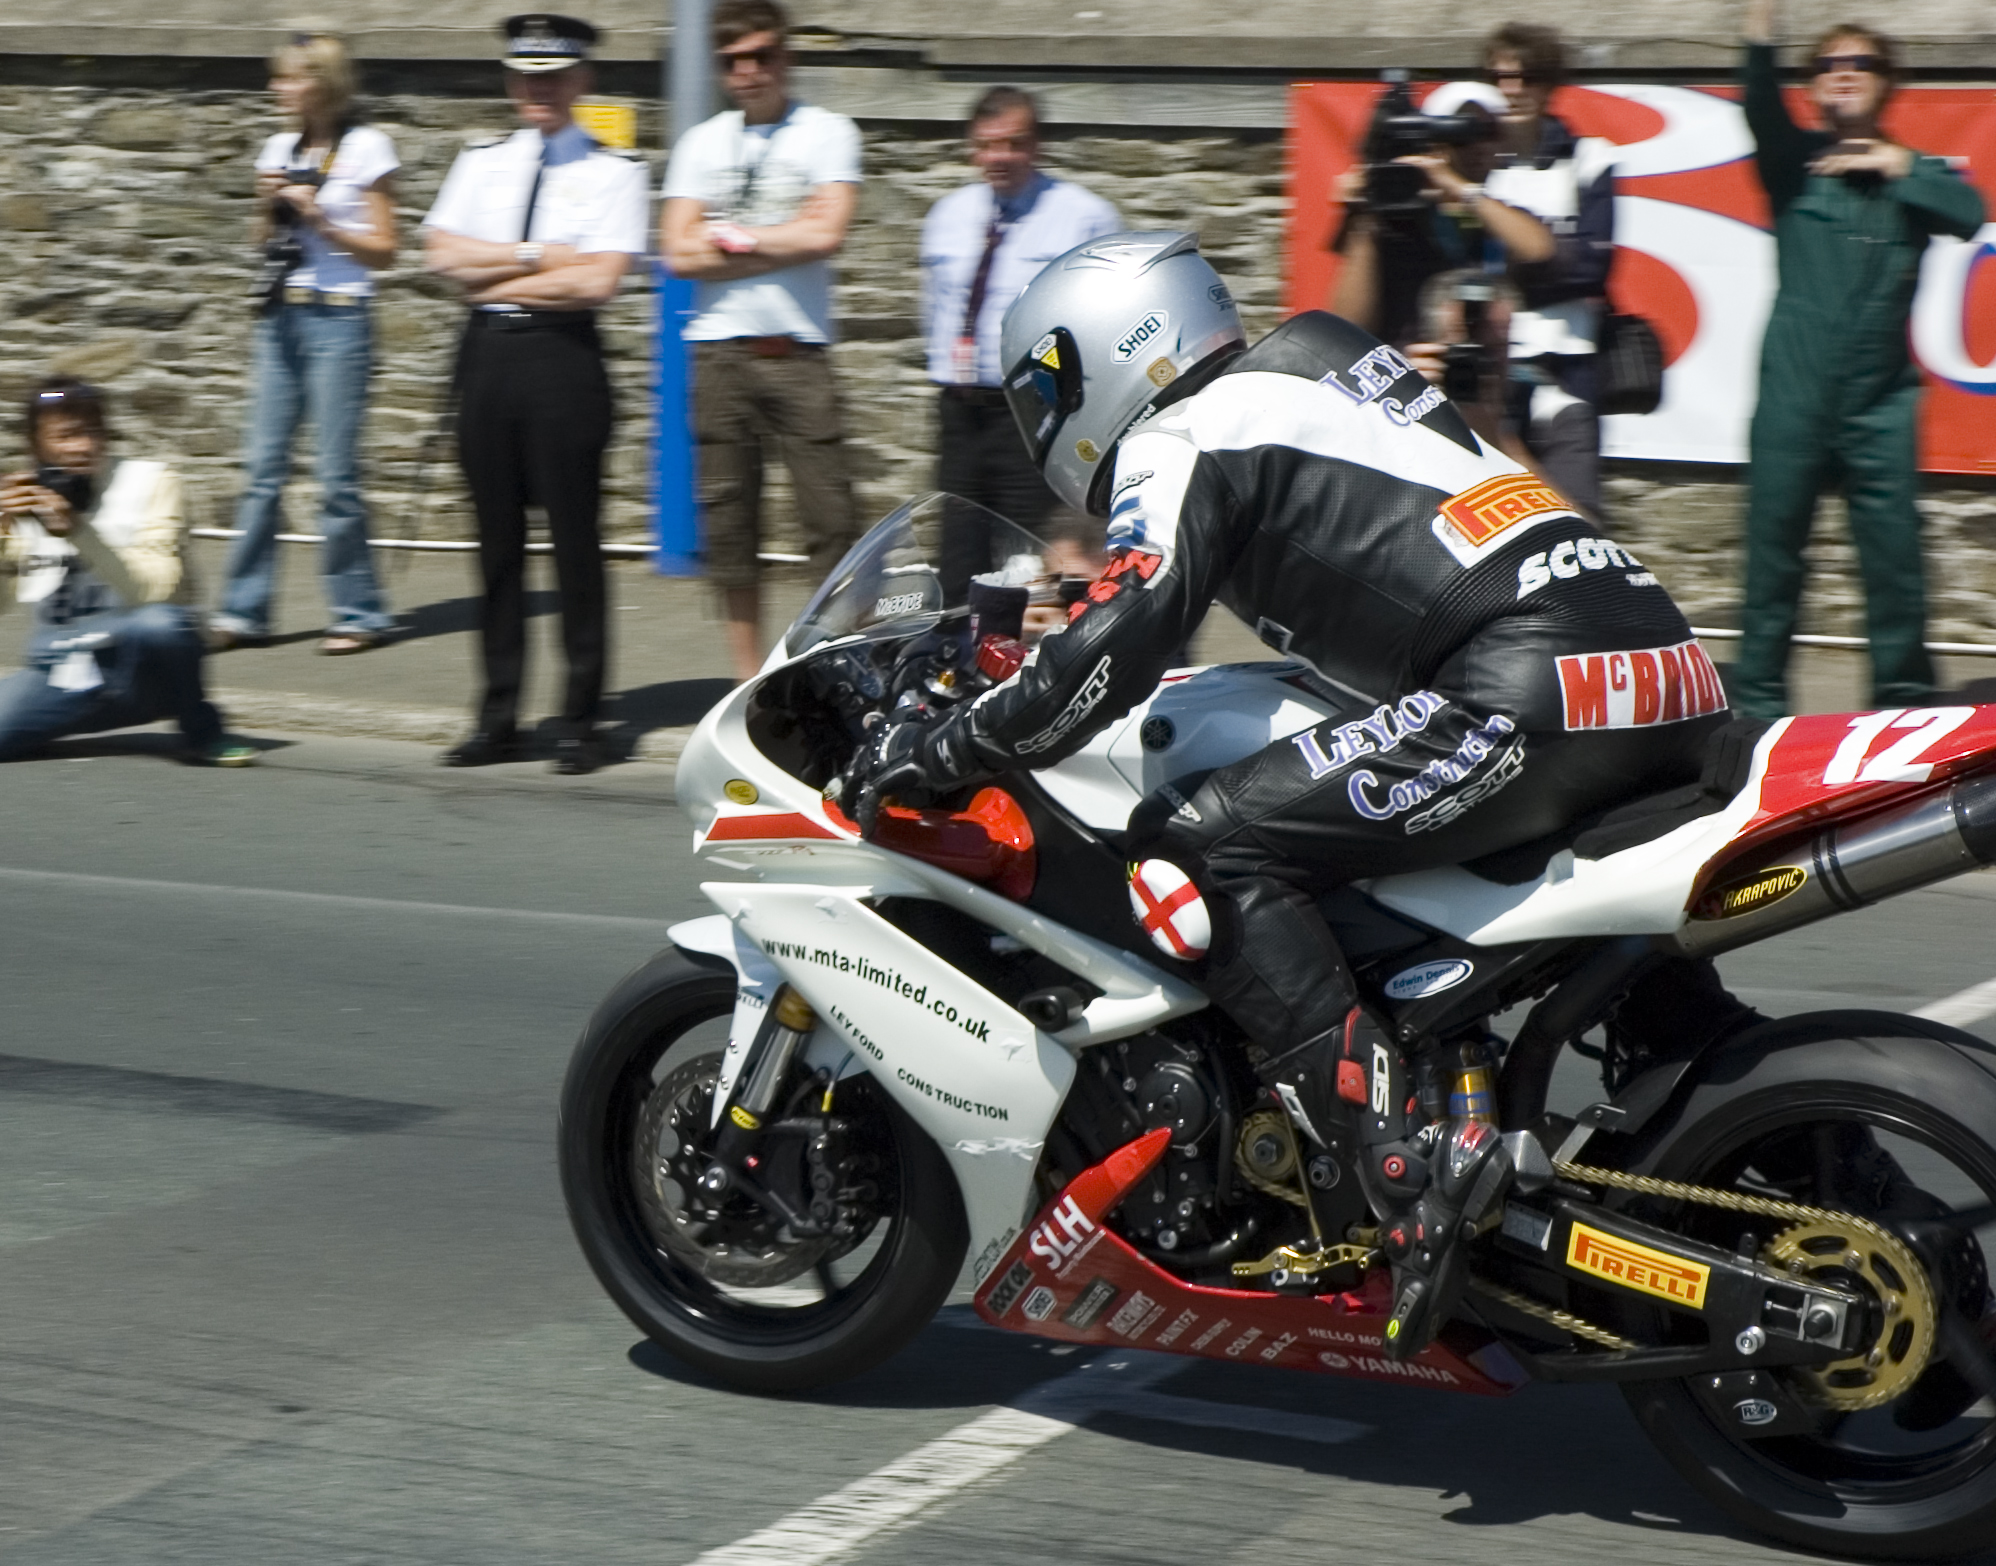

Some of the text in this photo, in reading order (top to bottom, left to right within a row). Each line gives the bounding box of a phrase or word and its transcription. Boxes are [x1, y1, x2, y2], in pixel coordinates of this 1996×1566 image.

[1118, 316, 1161, 358] SHOEI
[1015, 655, 1112, 754] SCOTT
[1823, 706, 1976, 785] 12
[1405, 734, 1526, 835] SCOTT
[762, 939, 991, 1043] www.mta-limited.co.uk
[1393, 974, 1423, 990] Edwin
[830, 1005, 1009, 1122] LEYFORD CONSTRUCTION
[1029, 1194, 1095, 1271] SLH
[1574, 1233, 1702, 1301] PIRELLI
[1307, 1326, 1384, 1346] HELLO MO
[1349, 1355, 1460, 1385] YAMAHA
